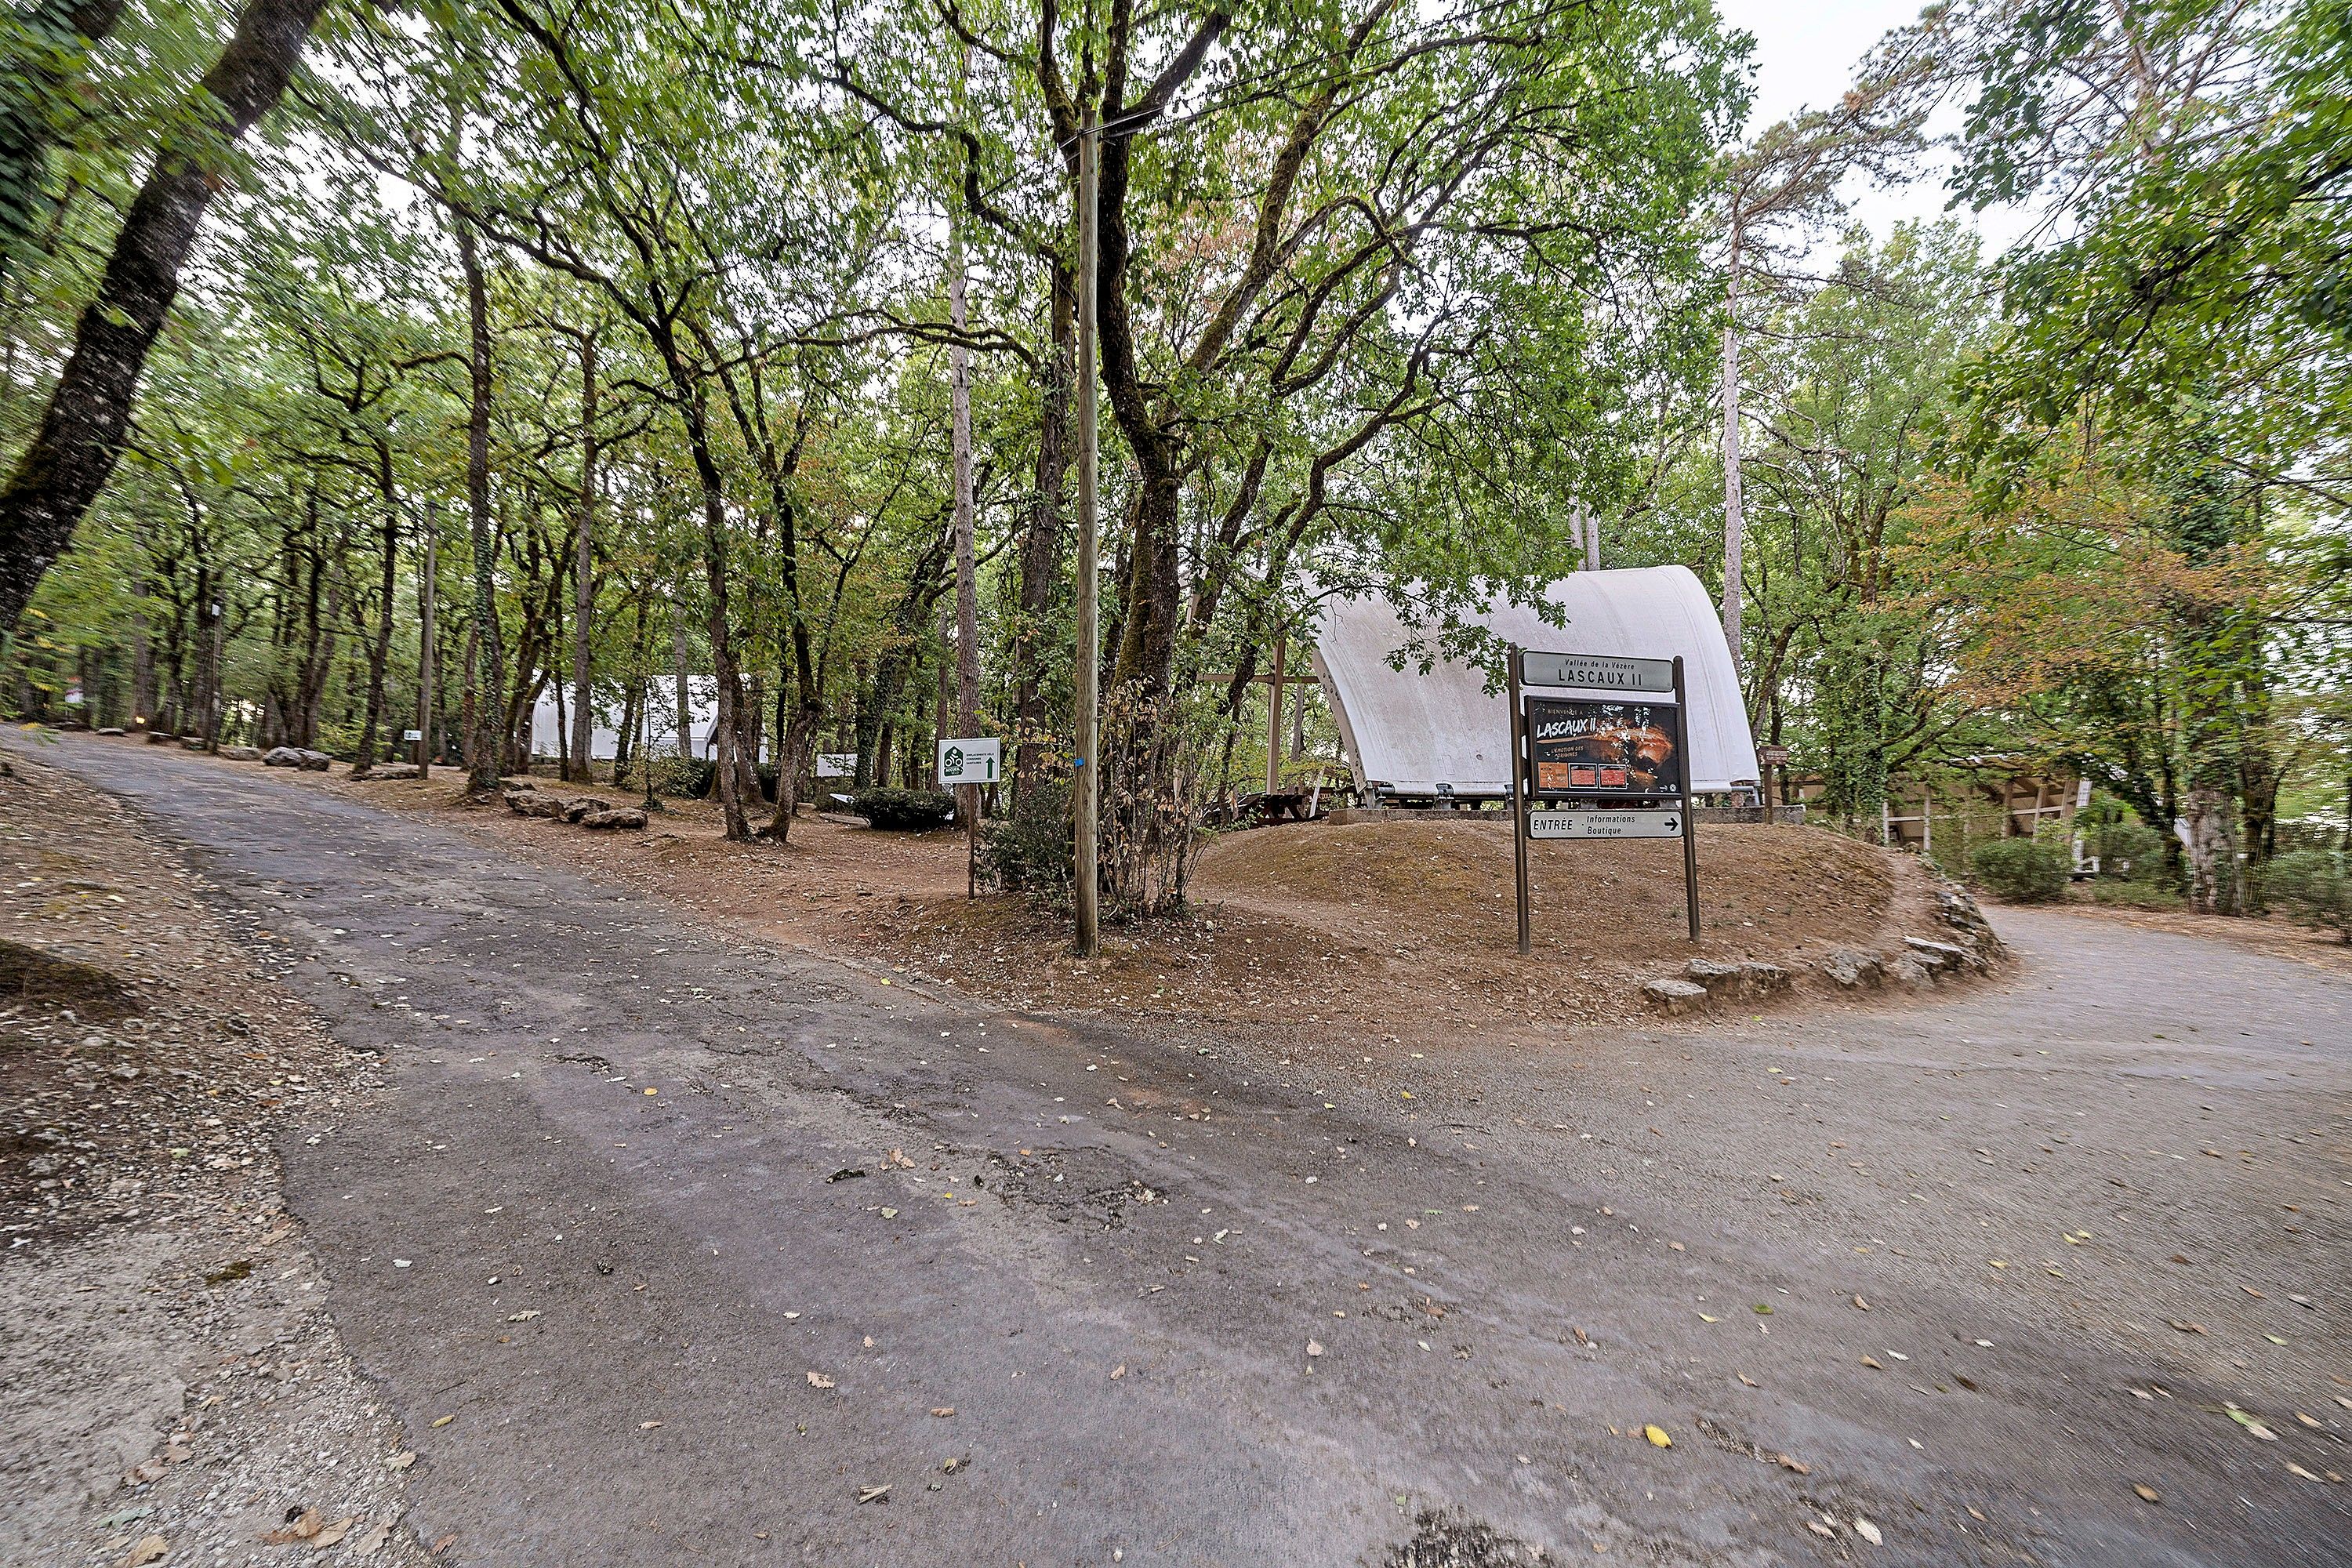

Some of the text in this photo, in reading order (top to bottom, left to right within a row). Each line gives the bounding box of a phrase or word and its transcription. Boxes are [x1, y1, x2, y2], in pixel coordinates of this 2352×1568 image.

[1565, 659, 1588, 667] Vallée
[1559, 669, 1642, 686] LASCAUX II
[1537, 717, 1596, 738] LASCAUX II
[1534, 817, 1573, 830] ENTRÉE
[1587, 826, 1621, 836] Boutique
